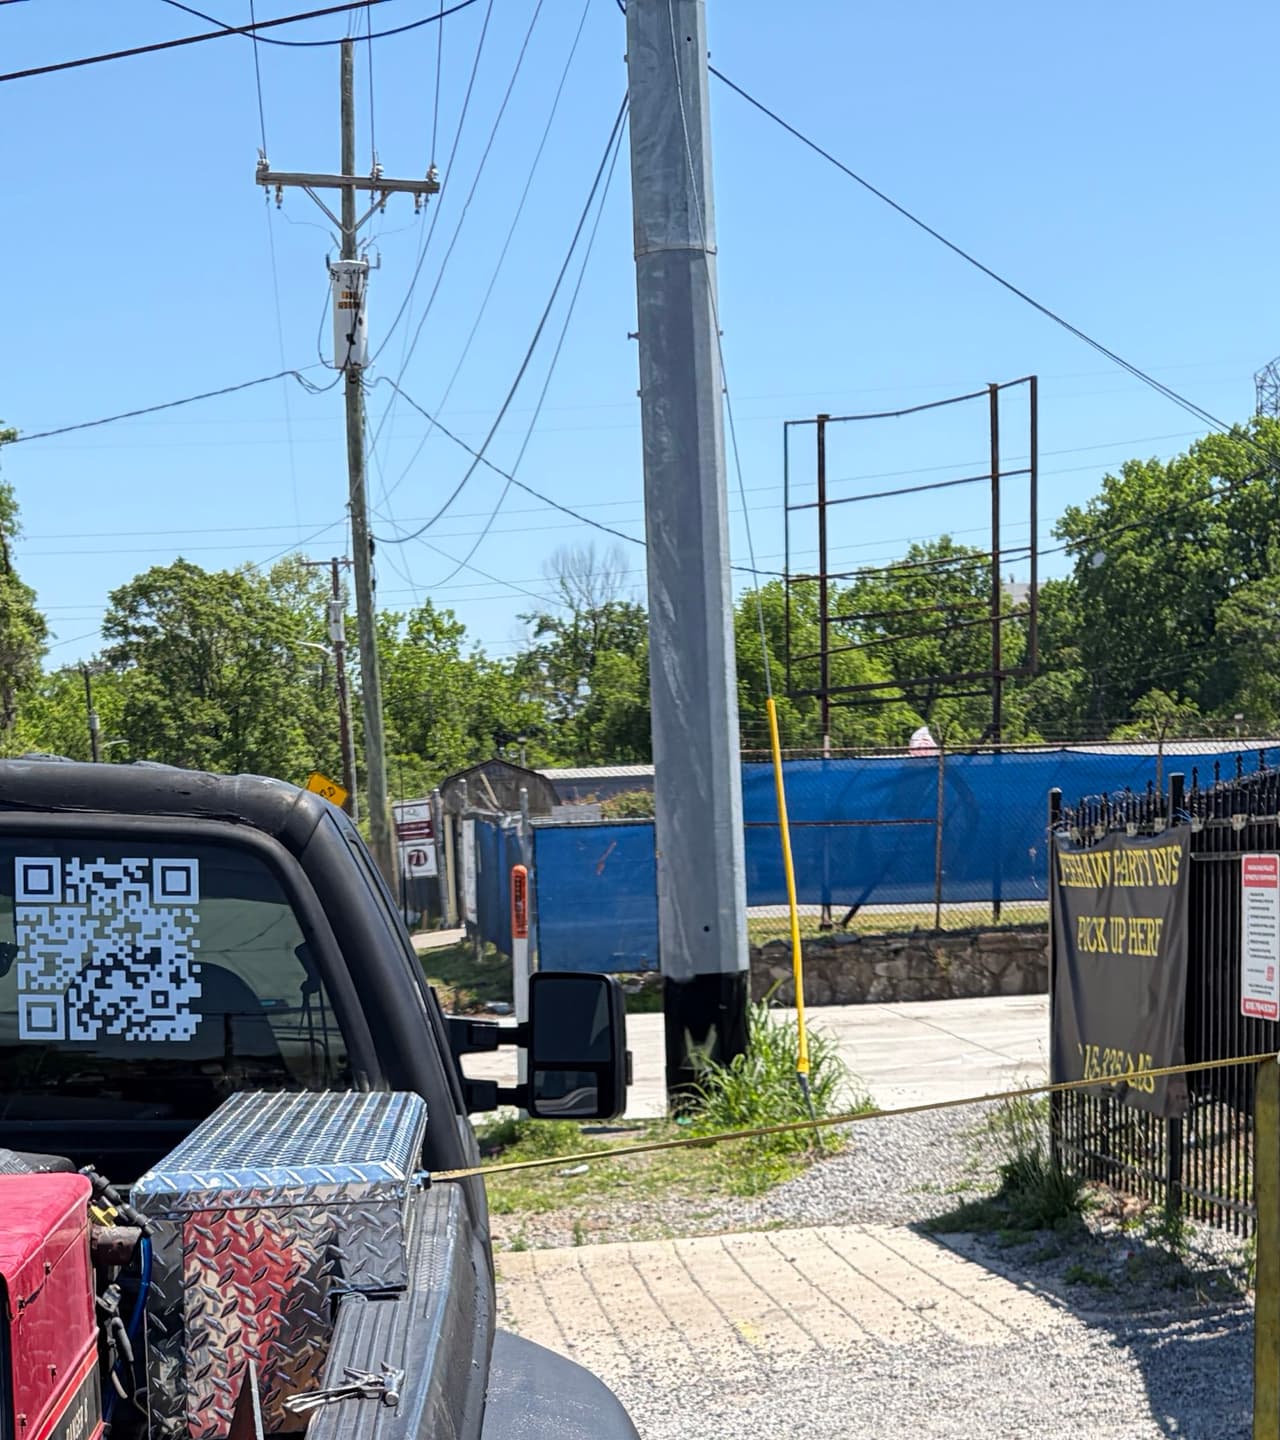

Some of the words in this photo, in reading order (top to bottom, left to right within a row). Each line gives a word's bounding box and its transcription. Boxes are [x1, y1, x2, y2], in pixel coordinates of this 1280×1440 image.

[409, 850, 426, 866] 71
[1113, 849, 1153, 887] PARTY
[1150, 845, 1182, 886] BUS
[1077, 916, 1108, 953] PICK
[1110, 917, 1126, 954] UP
